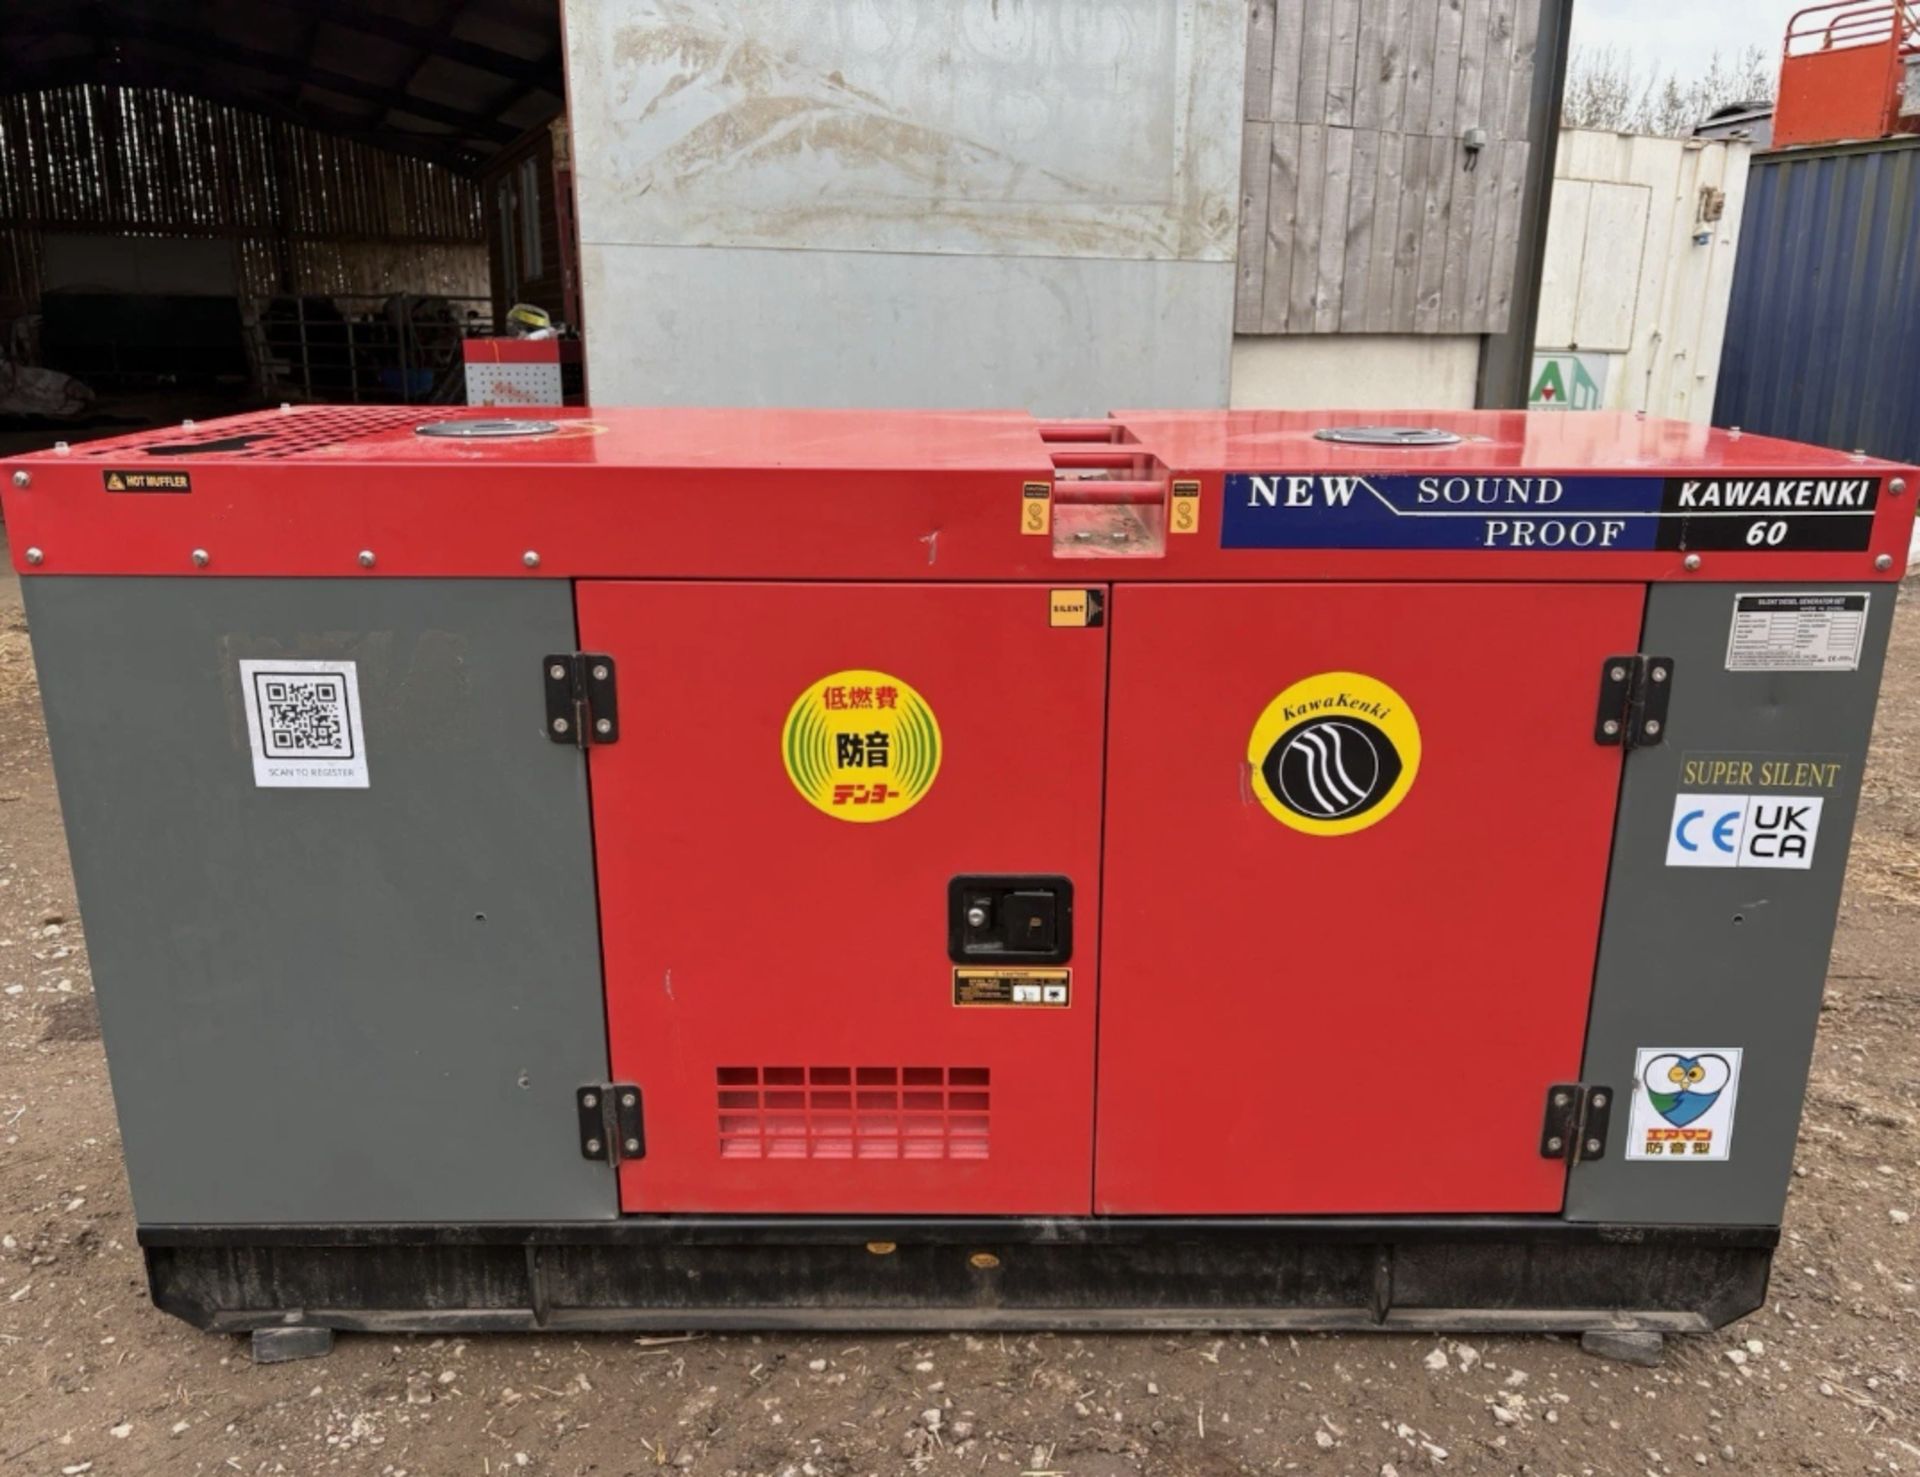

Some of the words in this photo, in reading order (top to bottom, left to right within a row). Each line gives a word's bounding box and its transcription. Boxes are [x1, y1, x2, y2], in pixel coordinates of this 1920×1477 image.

[125, 475, 145, 487] HOT
[146, 475, 188, 488] MUFFLER
[1248, 476, 1359, 507] NEW
[1418, 477, 1564, 503] SOUND
[1678, 480, 1869, 507] KAWAKENKI
[1483, 520, 1626, 546] PROOF
[1745, 521, 1788, 546] 60
[823, 686, 899, 710] 低燃費
[1282, 693, 1391, 721] KawaKenki
[836, 731, 889, 769] 防音
[268, 768, 294, 777] SCAN
[296, 768, 309, 777] TO
[311, 768, 355, 777] REGISTER
[1684, 761, 1753, 785] SUPER
[1759, 762, 1841, 787] SILENT
[1755, 805, 1811, 831] UK
[1676, 810, 1741, 853] CE
[1750, 834, 1807, 859] CA
